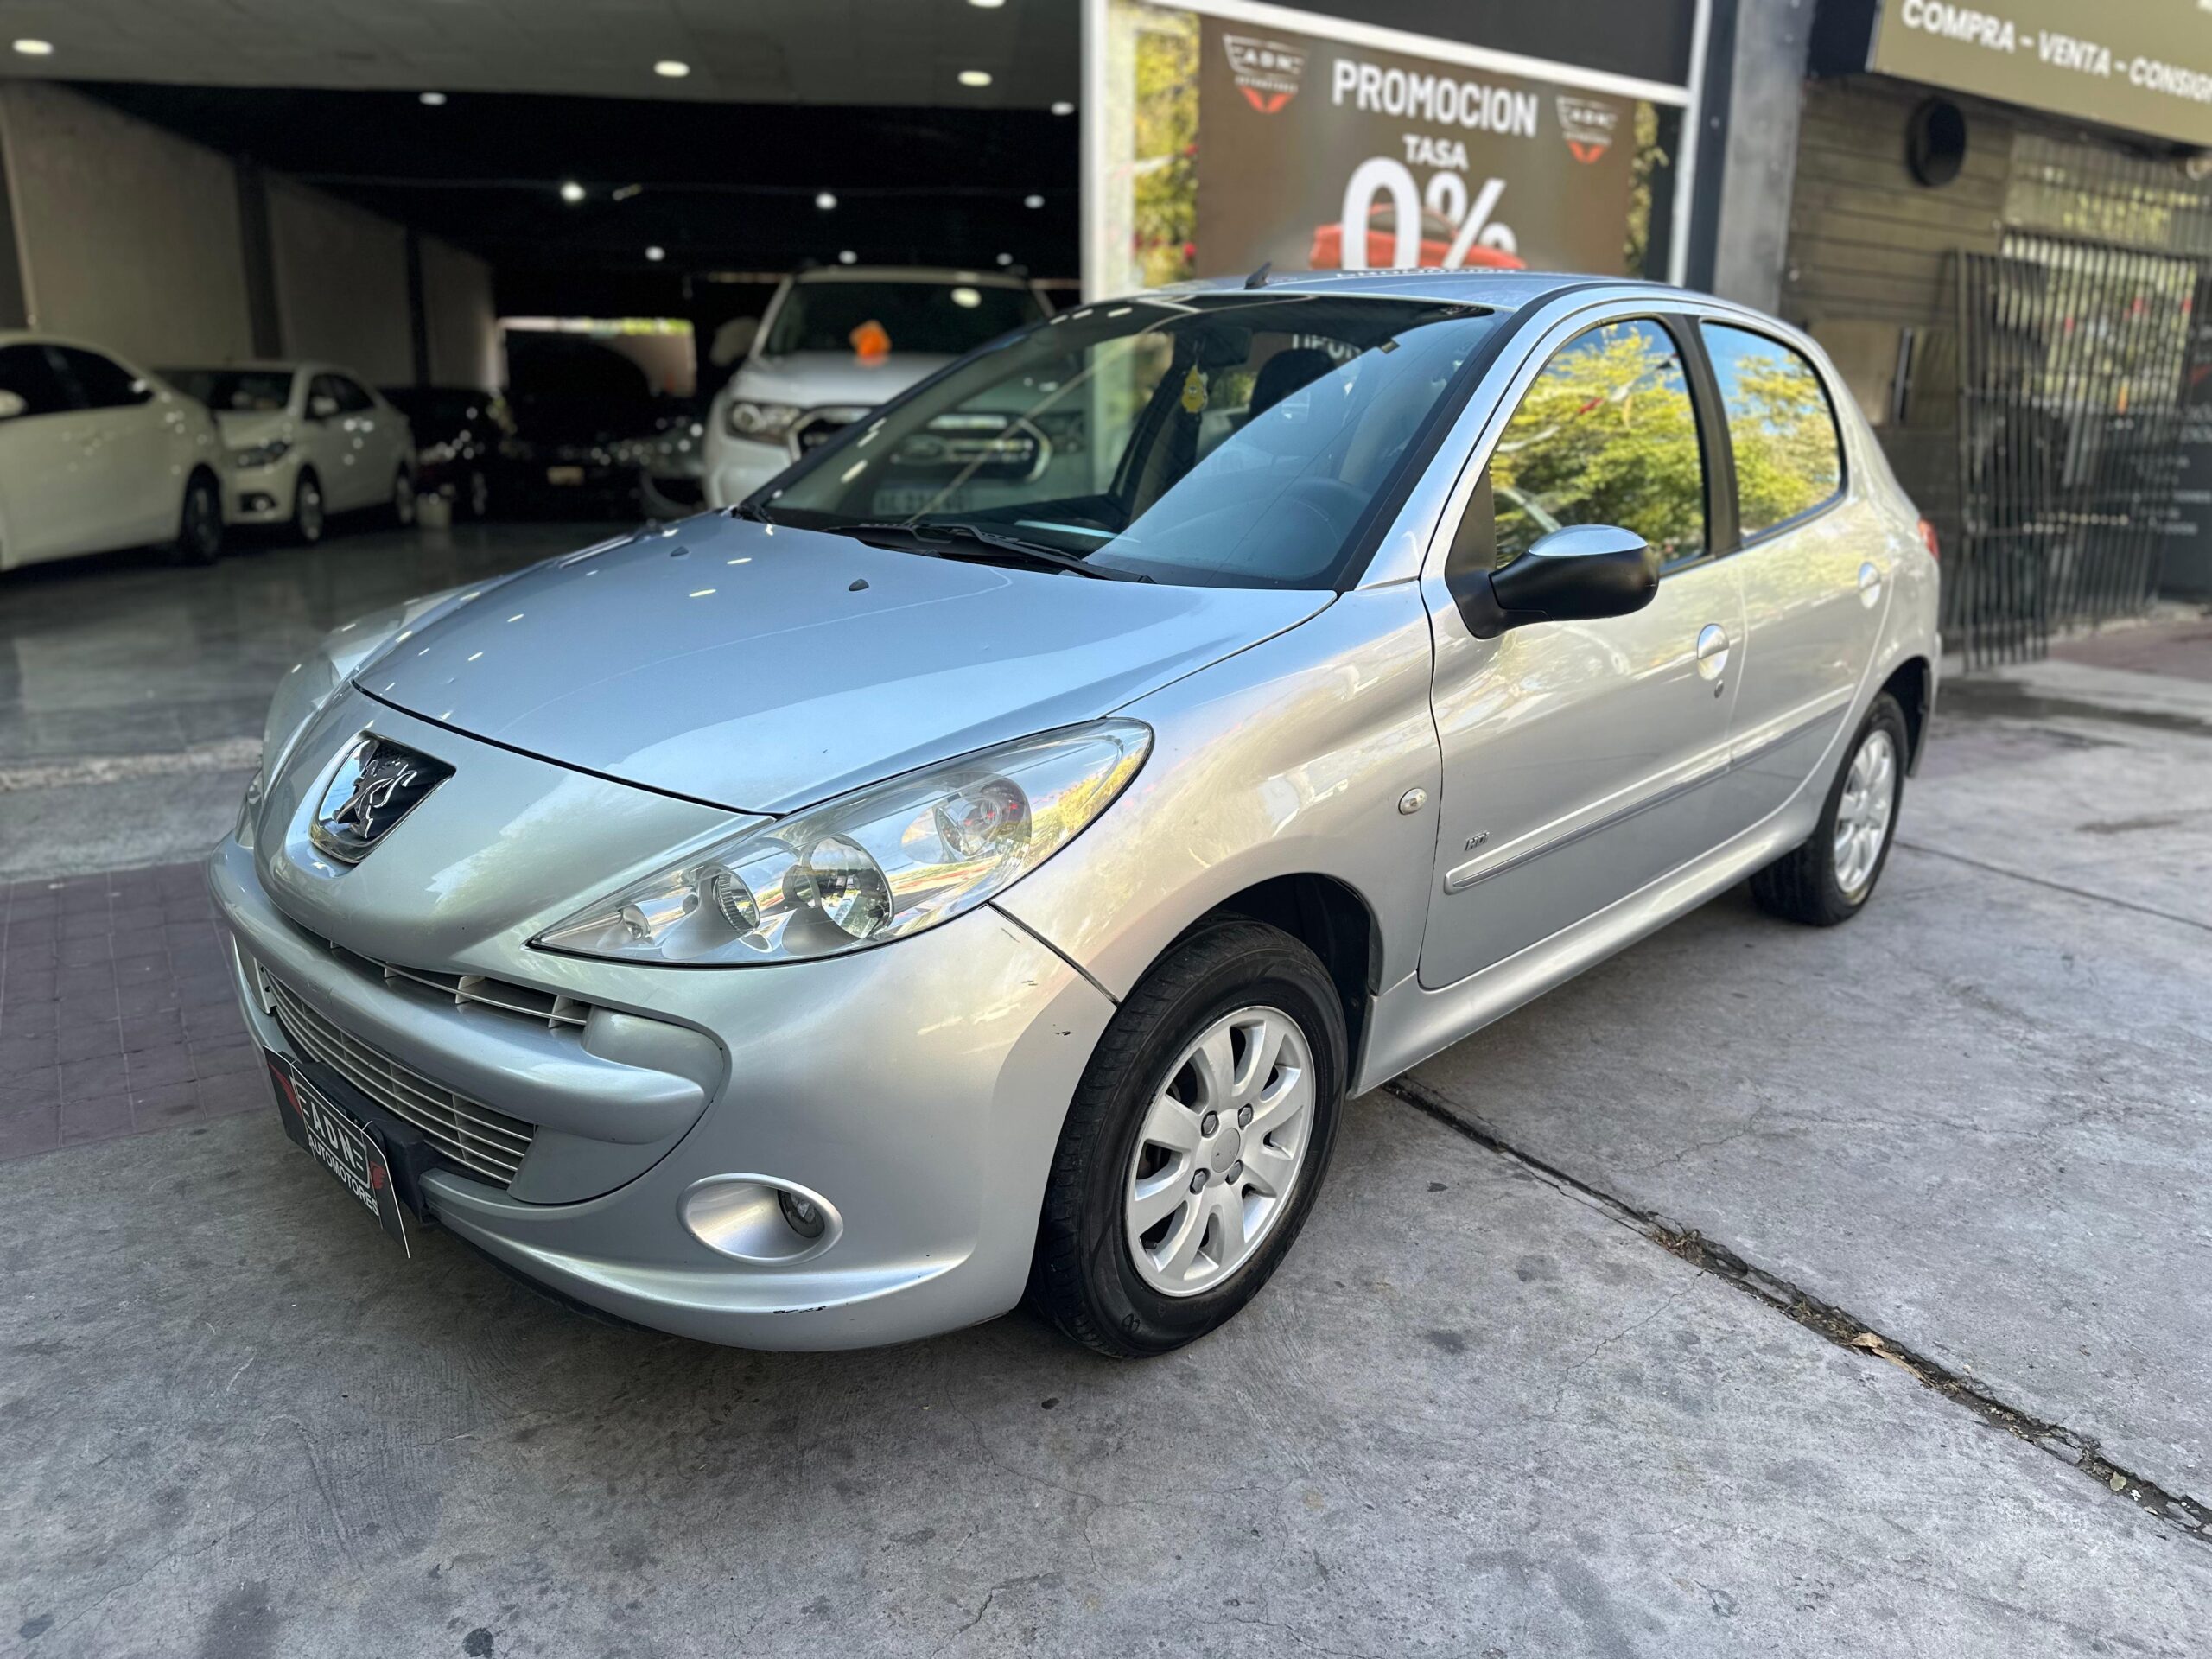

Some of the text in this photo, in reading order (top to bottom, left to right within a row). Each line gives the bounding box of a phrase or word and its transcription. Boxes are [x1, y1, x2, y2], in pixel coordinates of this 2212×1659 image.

[1901, 0, 2016, 53] COMPRA
[2038, 30, 2111, 77] VENTA
[1332, 58, 1538, 138] PROMOCION
[1402, 134, 1468, 171] TASA
[1342, 156, 1517, 270] 0%
[308, 1132, 380, 1217] AUTOMOTORES
